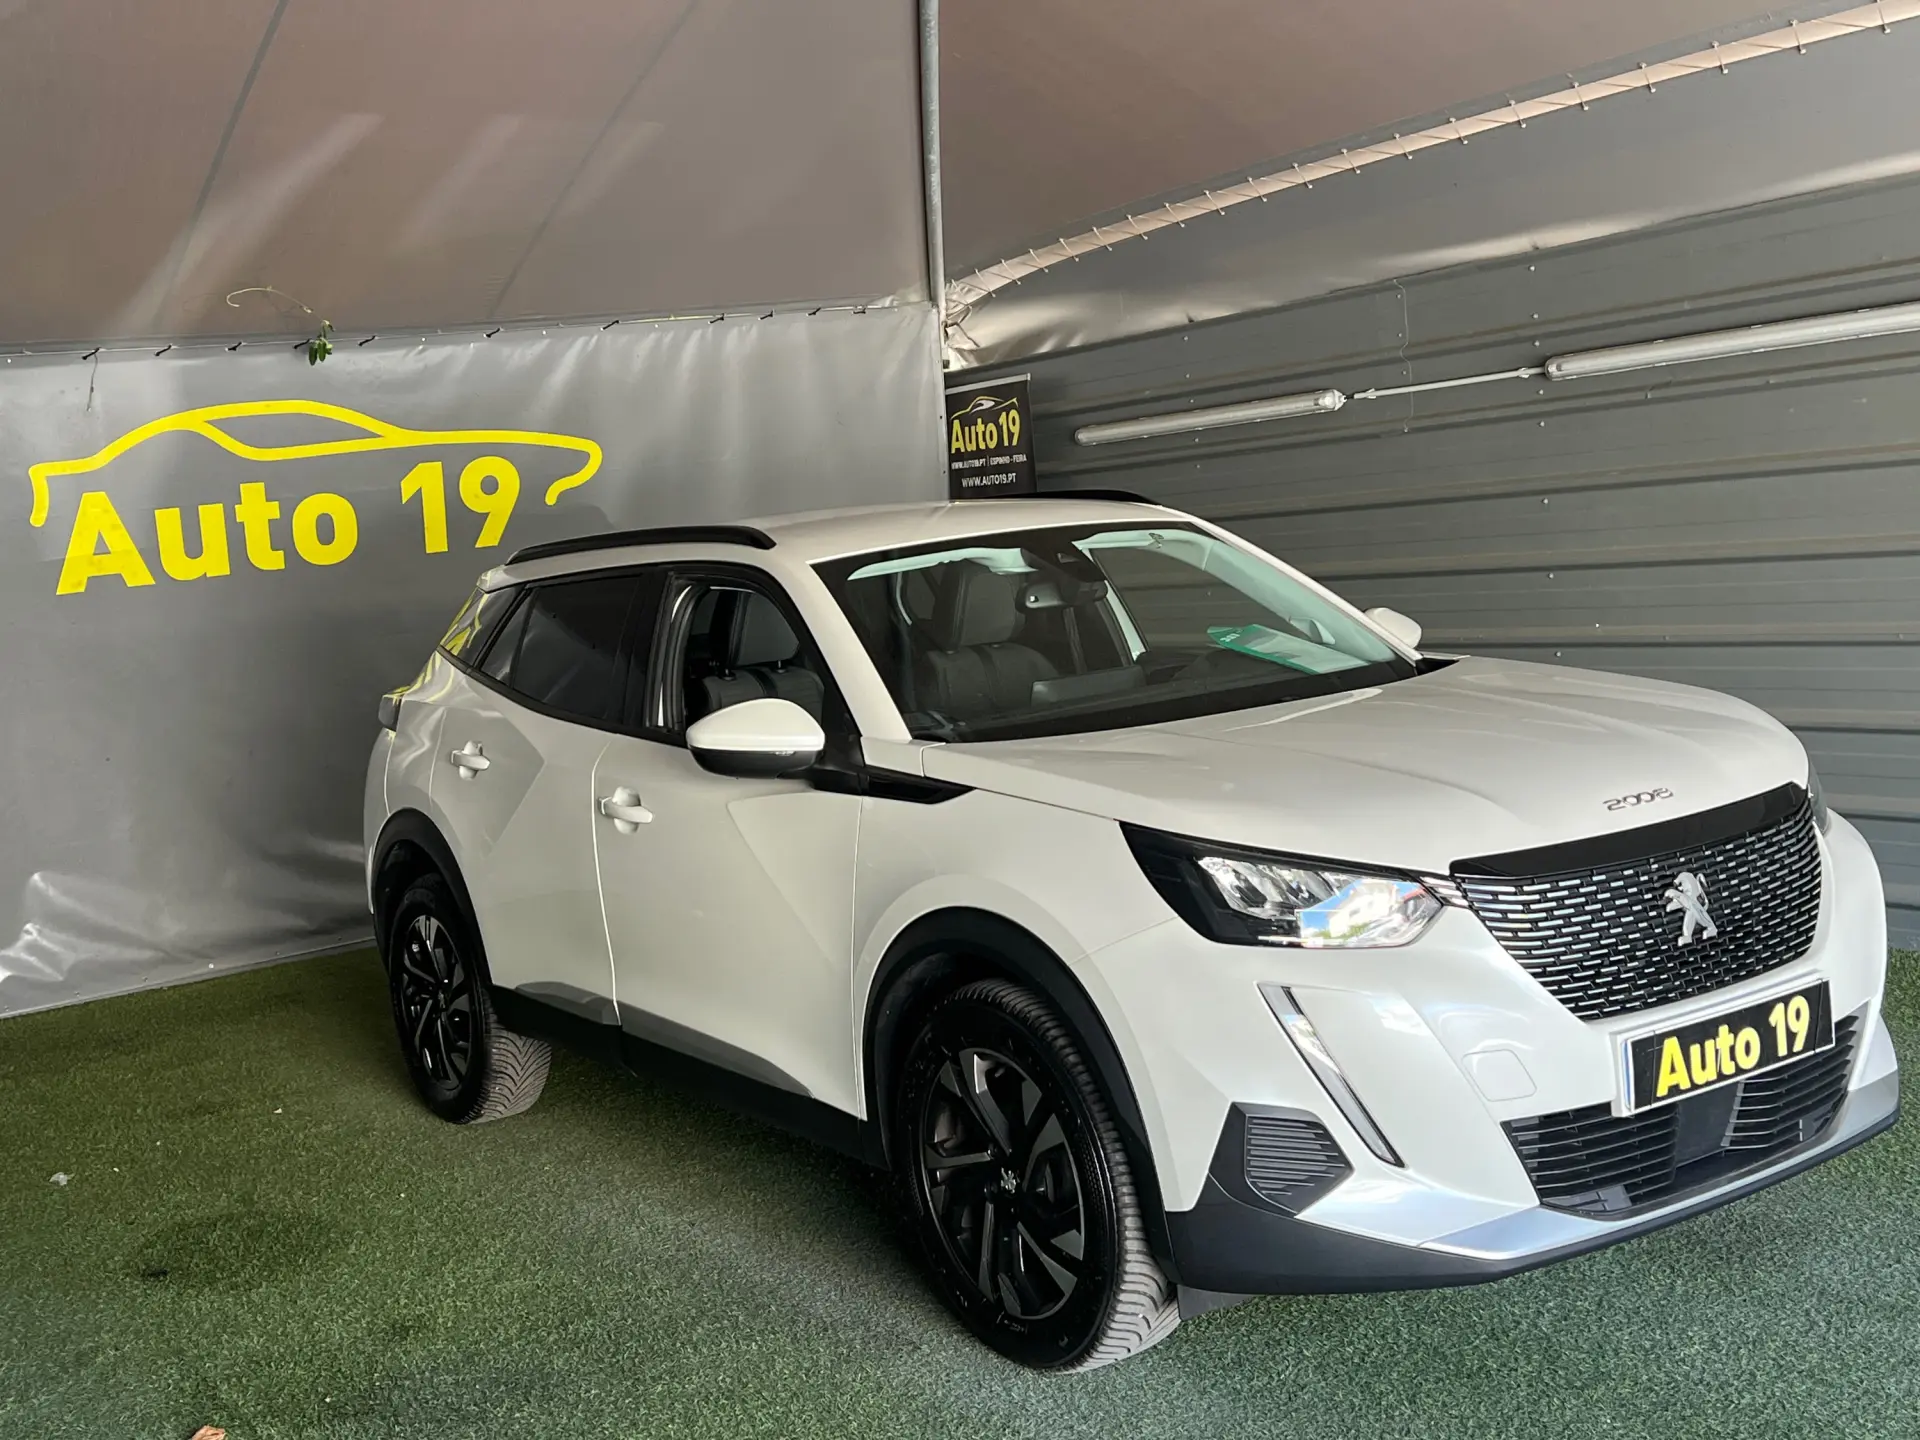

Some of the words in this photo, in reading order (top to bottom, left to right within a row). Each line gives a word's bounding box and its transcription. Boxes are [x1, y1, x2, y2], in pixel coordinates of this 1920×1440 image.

[951, 417, 998, 454] Auto
[998, 409, 1021, 446] 19
[962, 473, 1017, 487] WWW.AUTO19.PT
[56, 482, 359, 596] Auto
[400, 456, 521, 555] 19
[1603, 787, 1674, 811] 2008
[1656, 1024, 1760, 1098] Auto
[1768, 995, 1810, 1057] 19
